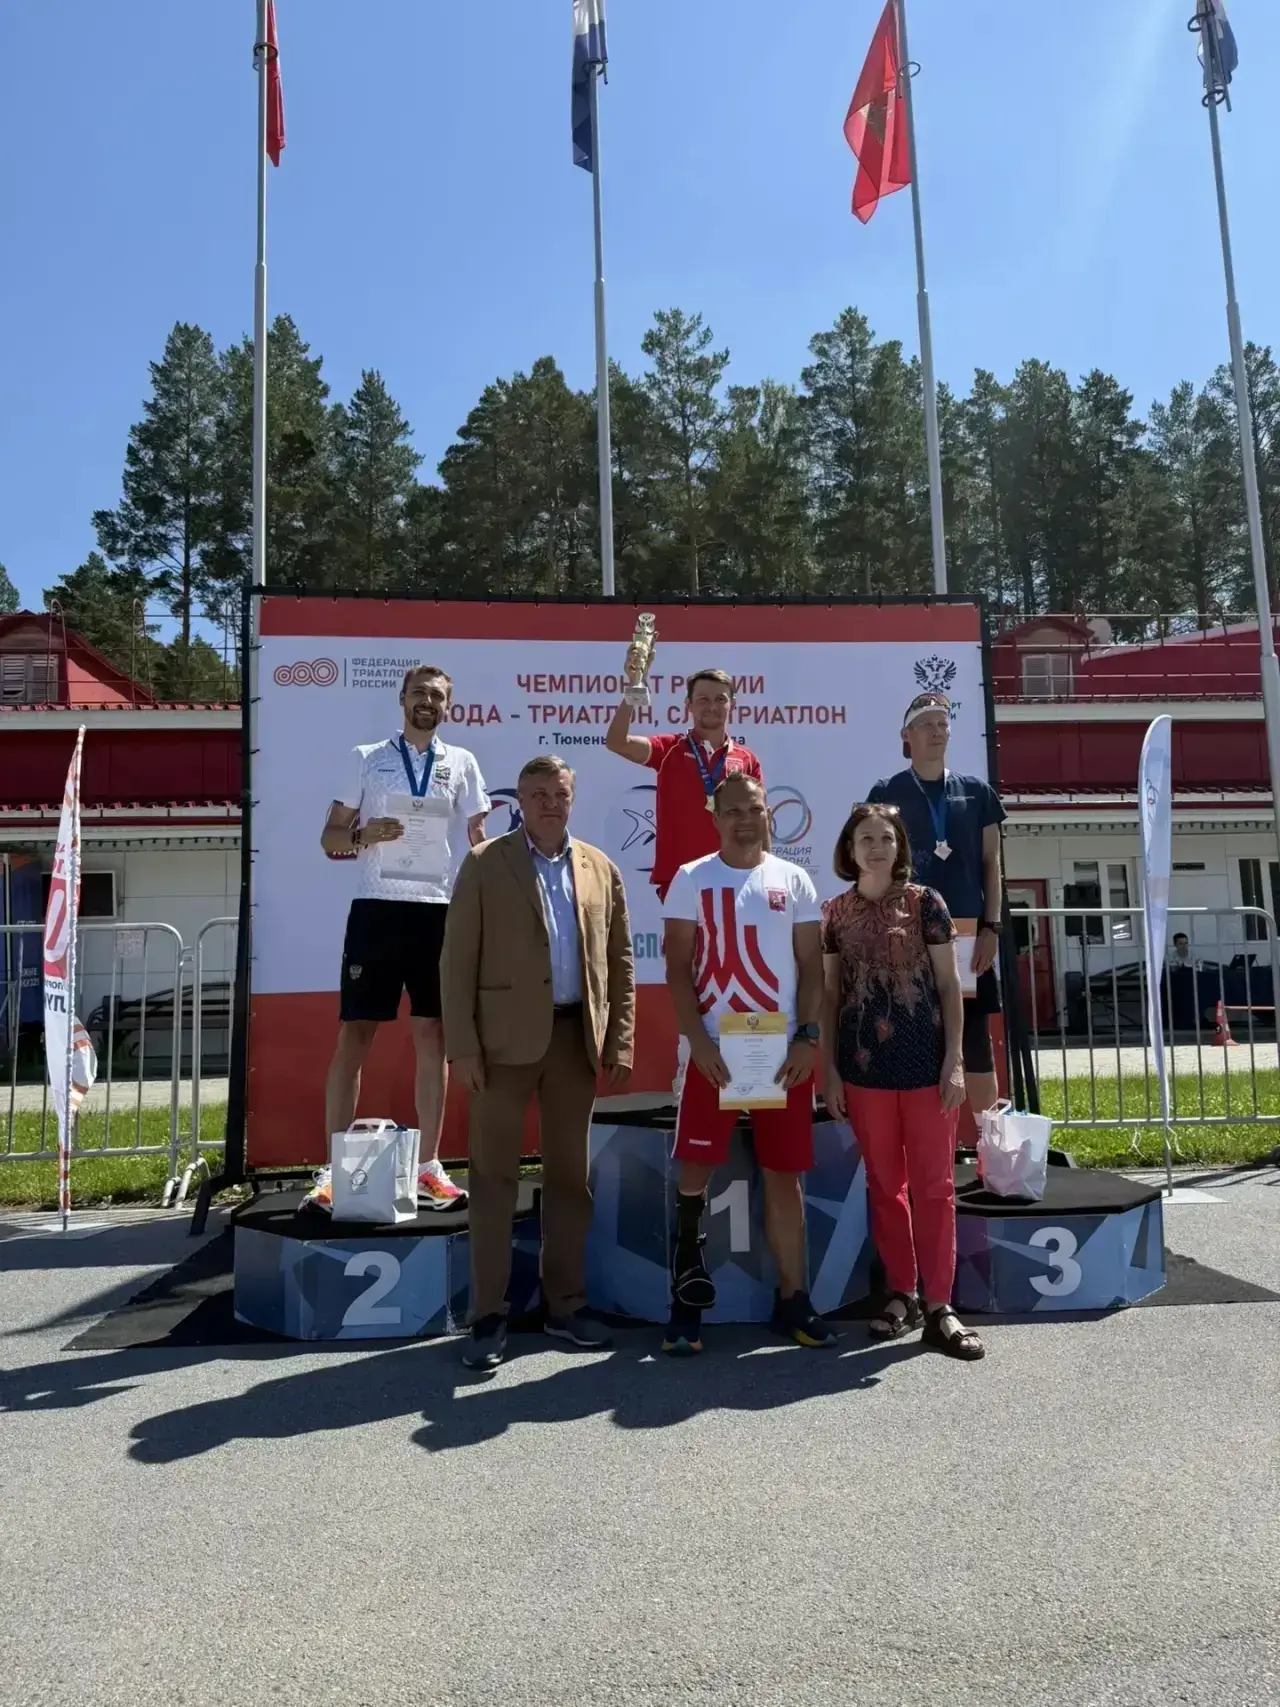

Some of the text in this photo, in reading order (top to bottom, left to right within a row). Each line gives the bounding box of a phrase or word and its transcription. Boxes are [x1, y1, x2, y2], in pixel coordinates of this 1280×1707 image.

[351, 658, 421, 668] ФЕДЕРАЦИЯ
[351, 669, 405, 678] ТРИАТЛО
[352, 679, 397, 688] РОССИИ
[516, 674, 765, 694] ЧЕМПИОНТ РИИ
[538, 735, 549, 745] г.
[771, 846, 812, 856] ЕРАЦИЯ
[710, 1179, 750, 1252] 1
[1028, 1226, 1082, 1297] 3
[341, 1250, 401, 1326] 2
